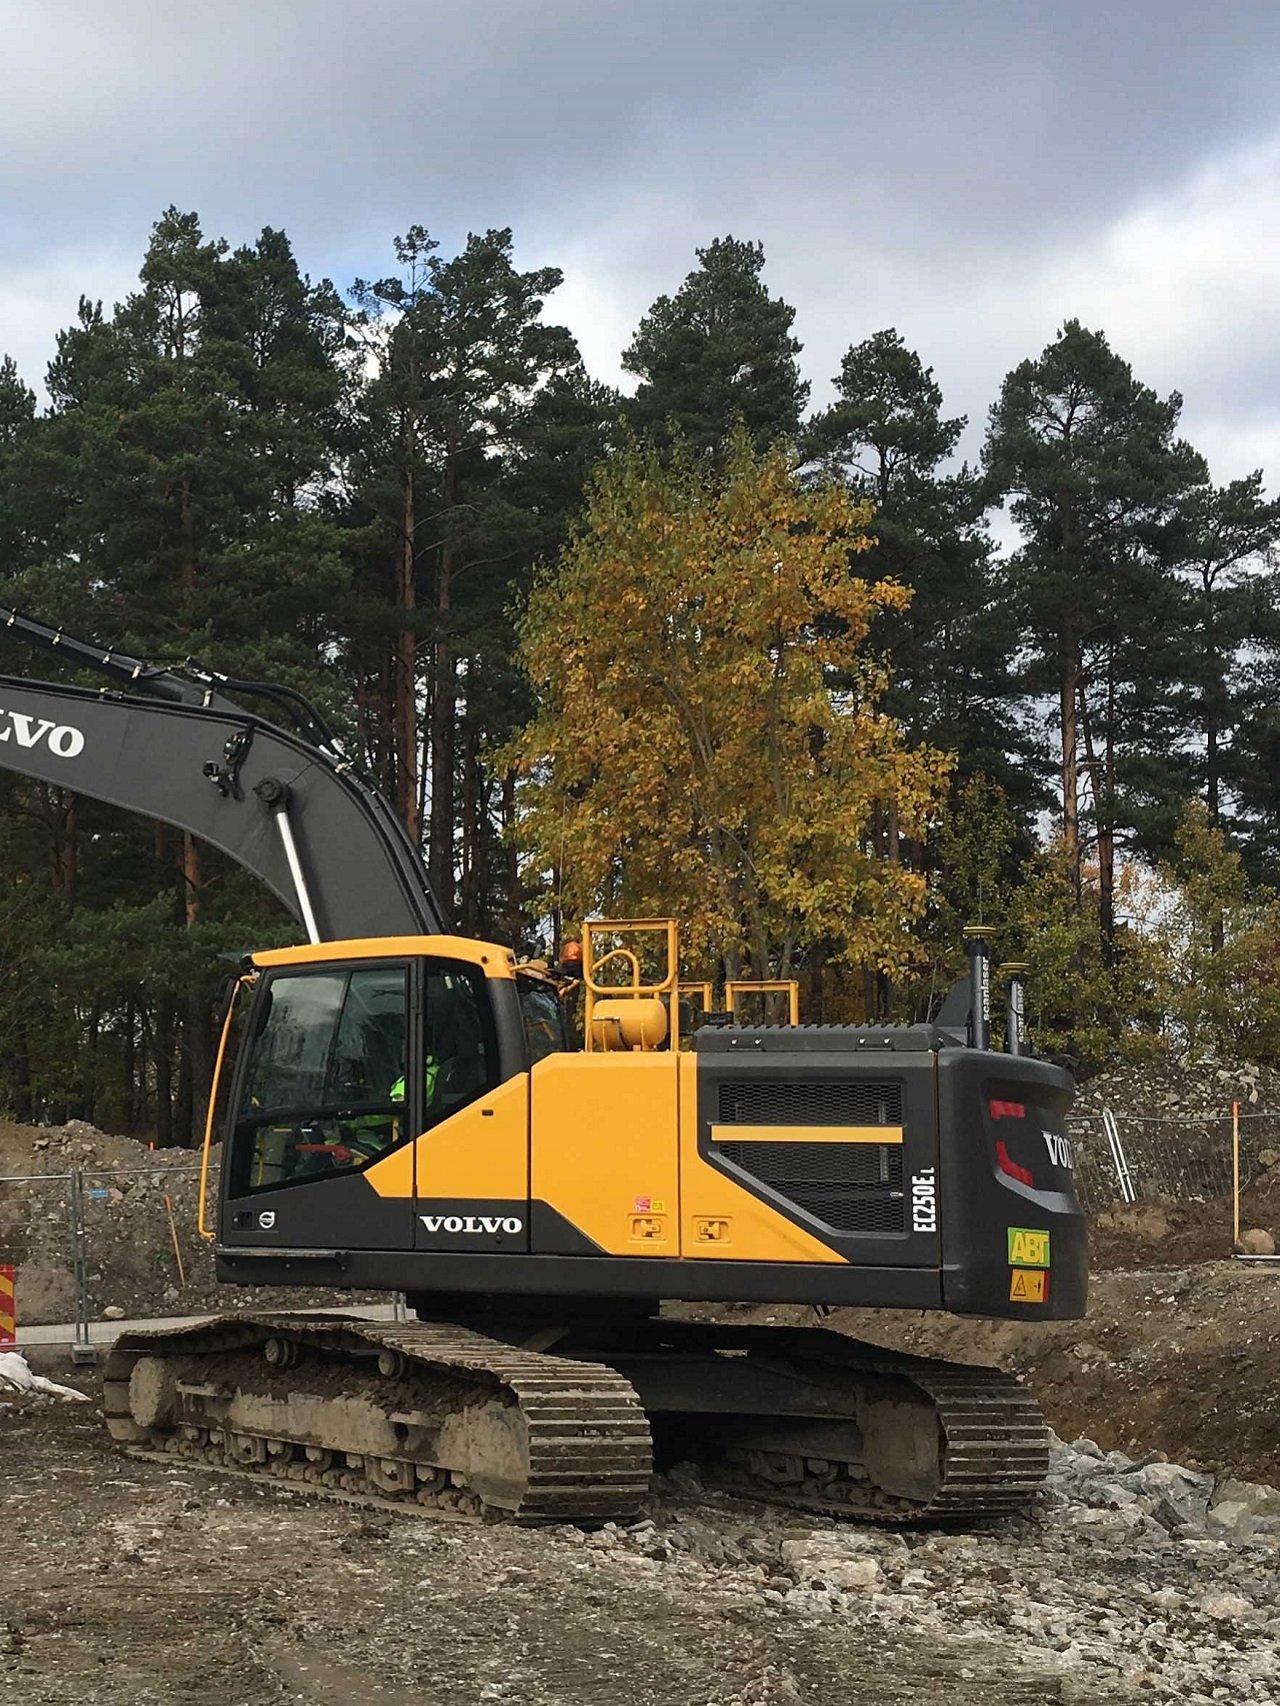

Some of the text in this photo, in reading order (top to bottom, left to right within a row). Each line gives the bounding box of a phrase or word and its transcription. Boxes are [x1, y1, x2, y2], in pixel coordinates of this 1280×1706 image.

[981, 956, 990, 1021] scanlaser
[420, 1216, 522, 1233] VOLVO
[1011, 1231, 1049, 1264] ABT
